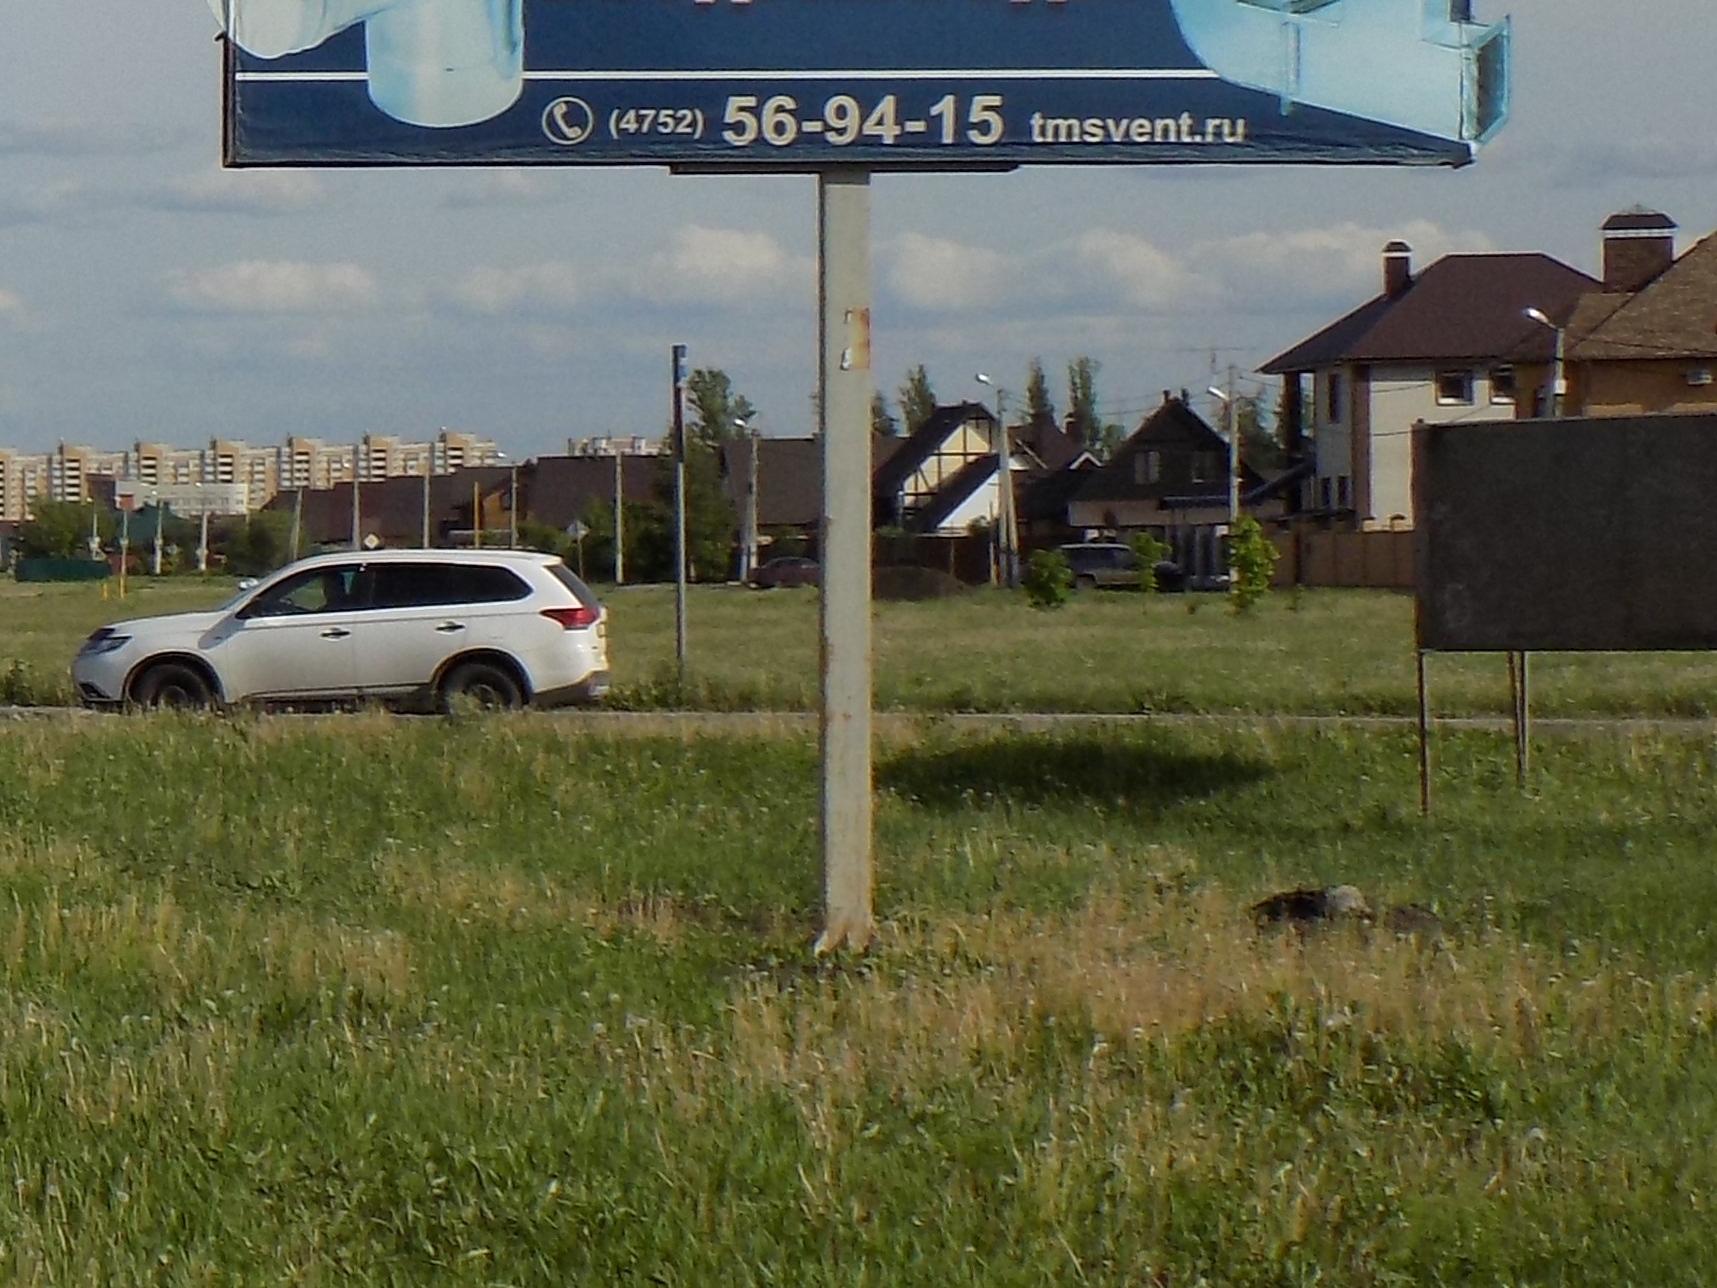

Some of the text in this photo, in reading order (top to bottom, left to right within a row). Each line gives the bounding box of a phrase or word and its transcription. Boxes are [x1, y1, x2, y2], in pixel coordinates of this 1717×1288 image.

[609, 94, 1246, 145] (4752) 56-94-15 tmsvent.ru
